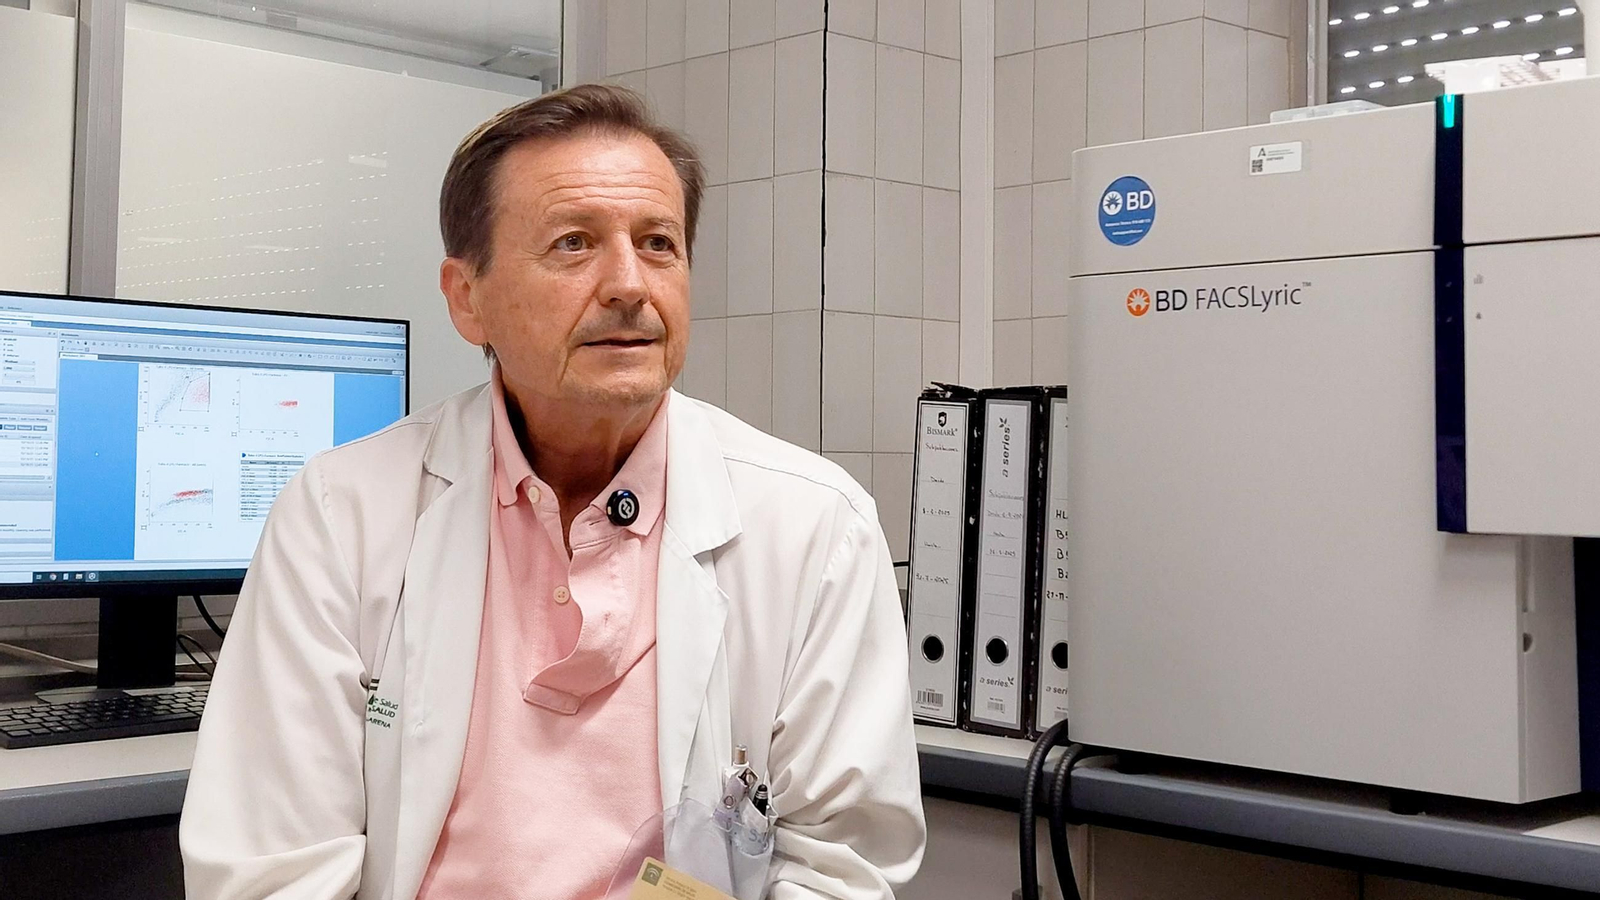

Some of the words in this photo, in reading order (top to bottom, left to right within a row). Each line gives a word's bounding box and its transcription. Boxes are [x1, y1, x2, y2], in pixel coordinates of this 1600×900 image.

[1126, 190, 1154, 211] BD
[1155, 288, 1188, 312] BD
[1053, 687, 1068, 695] seri
[366, 717, 391, 729] ARENA
